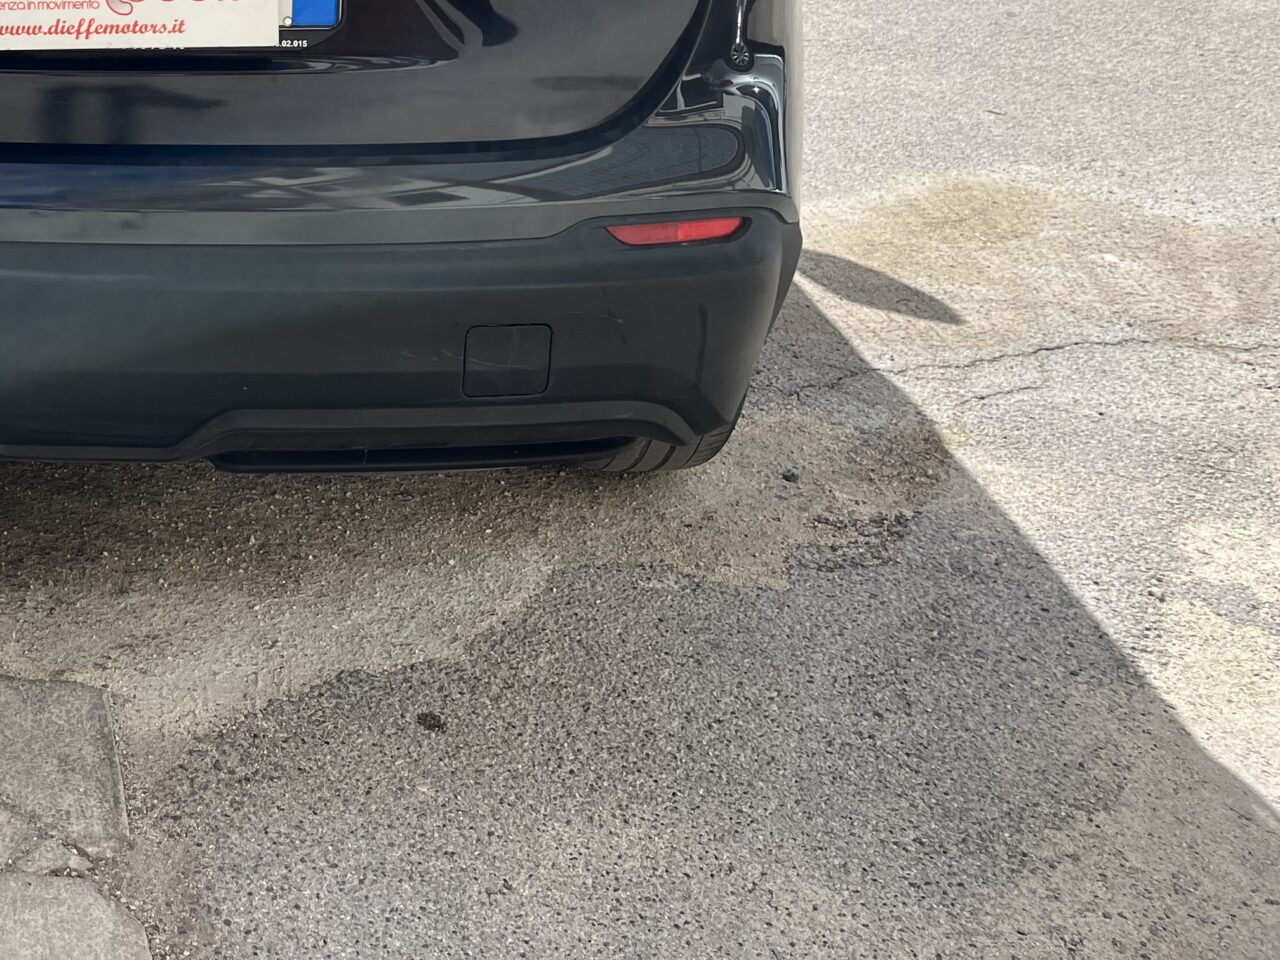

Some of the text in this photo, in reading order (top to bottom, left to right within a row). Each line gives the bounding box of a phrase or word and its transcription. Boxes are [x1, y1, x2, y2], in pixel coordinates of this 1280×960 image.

[27, 0, 37, 11] in
[37, 0, 100, 11] movimento
[276, 39, 308, 48] .02.015
